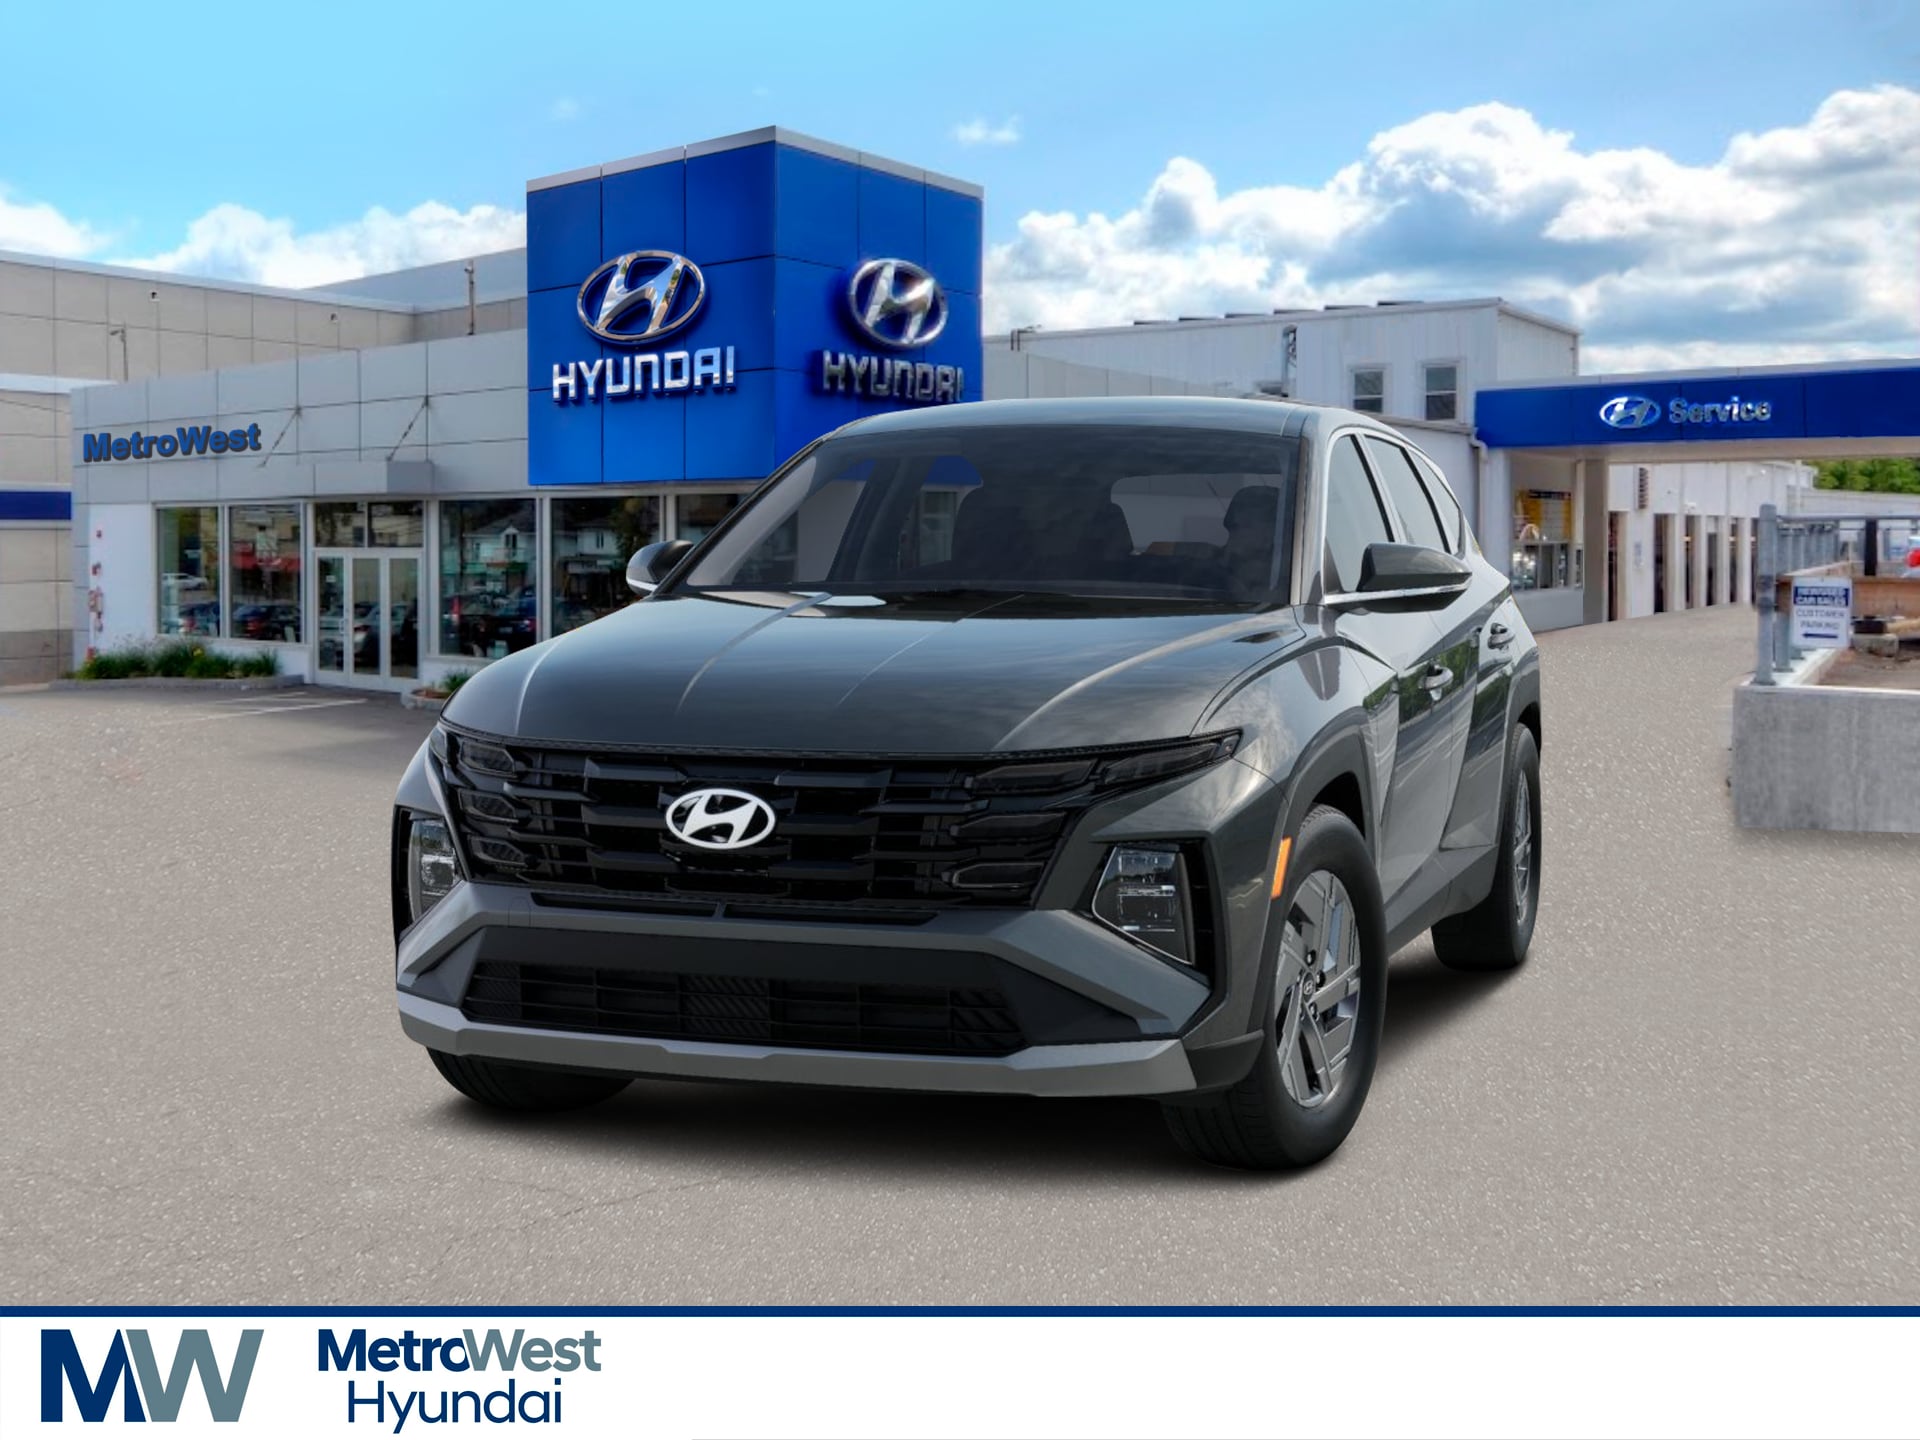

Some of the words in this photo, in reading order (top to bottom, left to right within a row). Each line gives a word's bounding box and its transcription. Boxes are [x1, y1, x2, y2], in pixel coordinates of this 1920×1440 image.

[552, 346, 735, 401] HYUNDAI
[821, 350, 964, 402] HYUNDAI
[1669, 395, 1772, 424] Service
[83, 423, 262, 462] MetroWest
